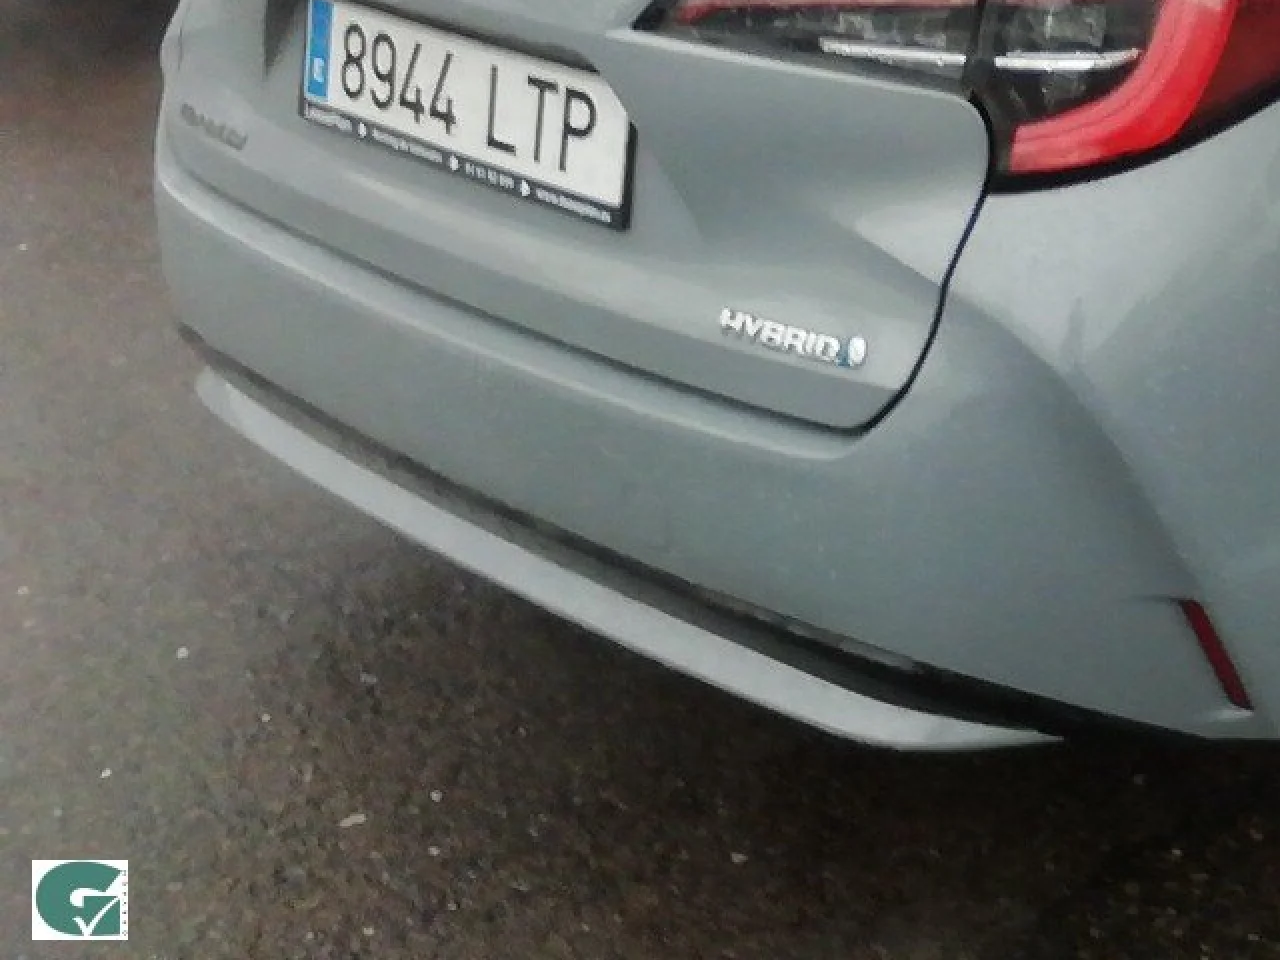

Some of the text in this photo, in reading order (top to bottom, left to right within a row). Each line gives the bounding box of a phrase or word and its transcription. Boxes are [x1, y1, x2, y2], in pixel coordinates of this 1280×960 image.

[341, 23, 456, 135] 8944
[487, 64, 597, 173] LTP
[720, 306, 841, 362] HYBRID
